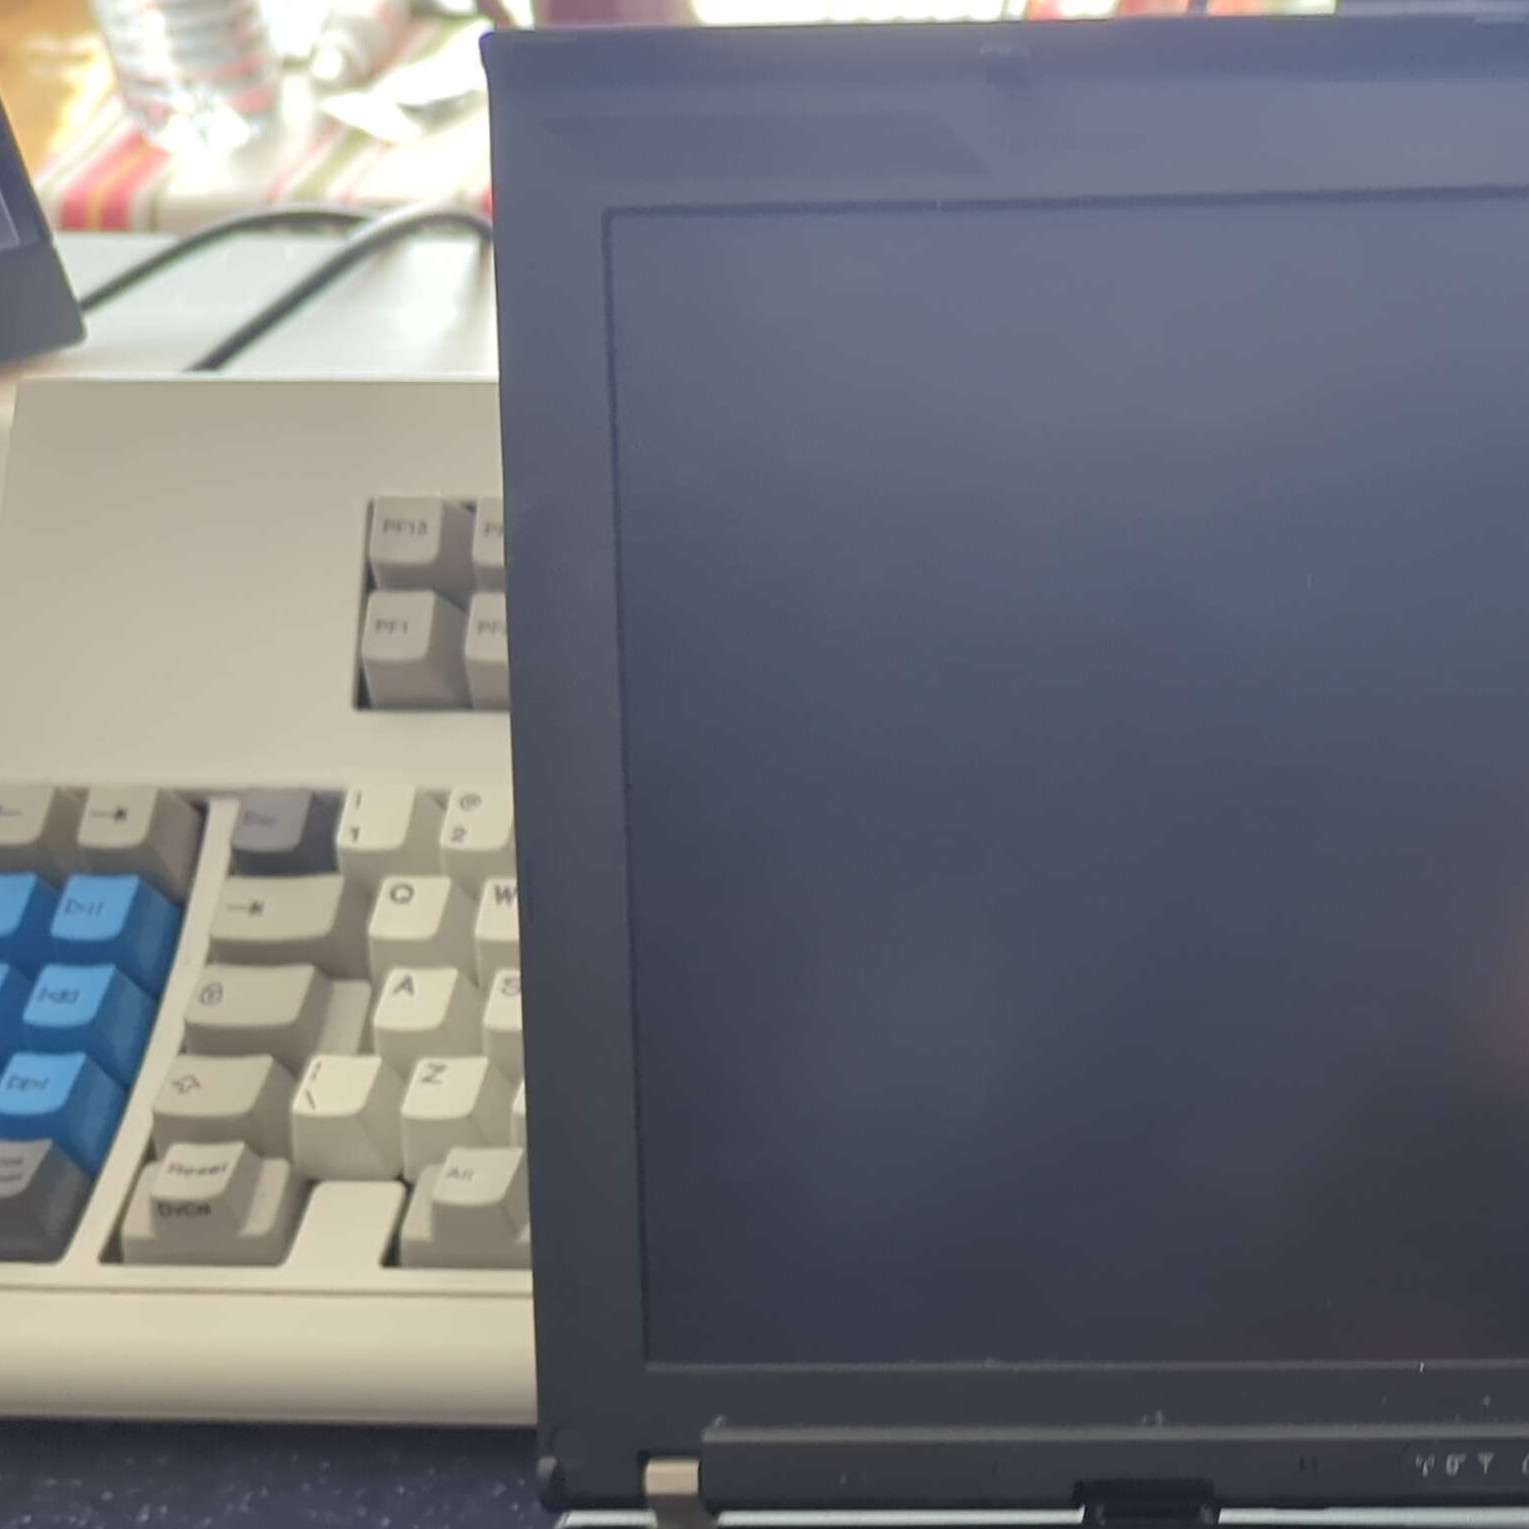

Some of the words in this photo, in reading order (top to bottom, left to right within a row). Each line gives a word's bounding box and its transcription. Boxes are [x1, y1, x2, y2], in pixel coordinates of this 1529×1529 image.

[450, 826, 467, 843] 2
[389, 882, 415, 905] Q
[393, 974, 415, 997] A
[501, 976, 521, 997] S
[420, 1062, 449, 1086] Z
